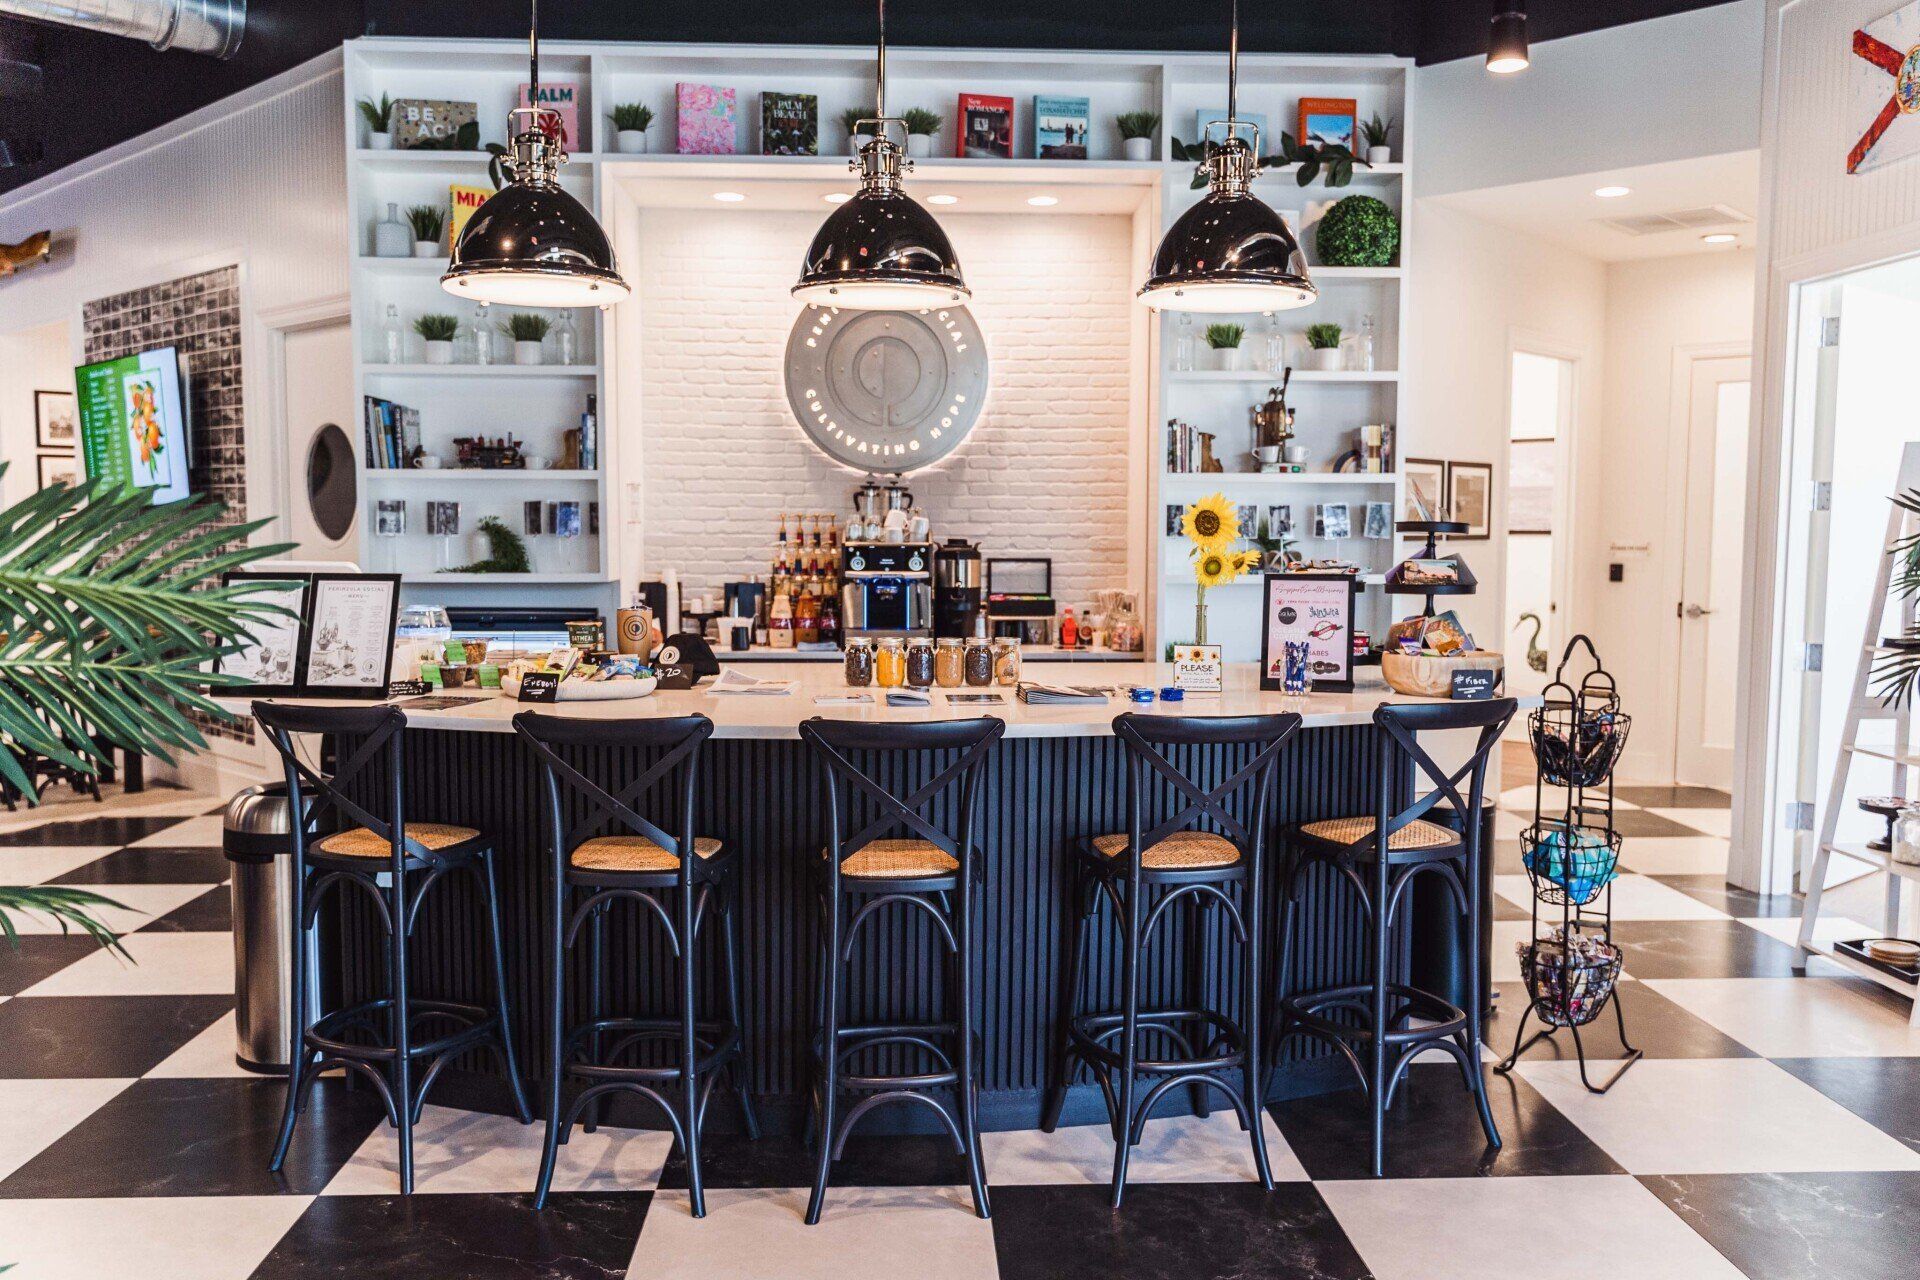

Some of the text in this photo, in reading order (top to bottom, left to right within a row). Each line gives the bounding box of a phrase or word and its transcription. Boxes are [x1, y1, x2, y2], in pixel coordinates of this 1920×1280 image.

[407, 106, 434, 122] BE
[456, 191, 486, 207] MIA
[806, 389, 920, 456] CULTIVATING
[929, 394, 966, 439] HOPE
[655, 667, 681, 681] $20
[1180, 664, 1214, 672] PLEASE
